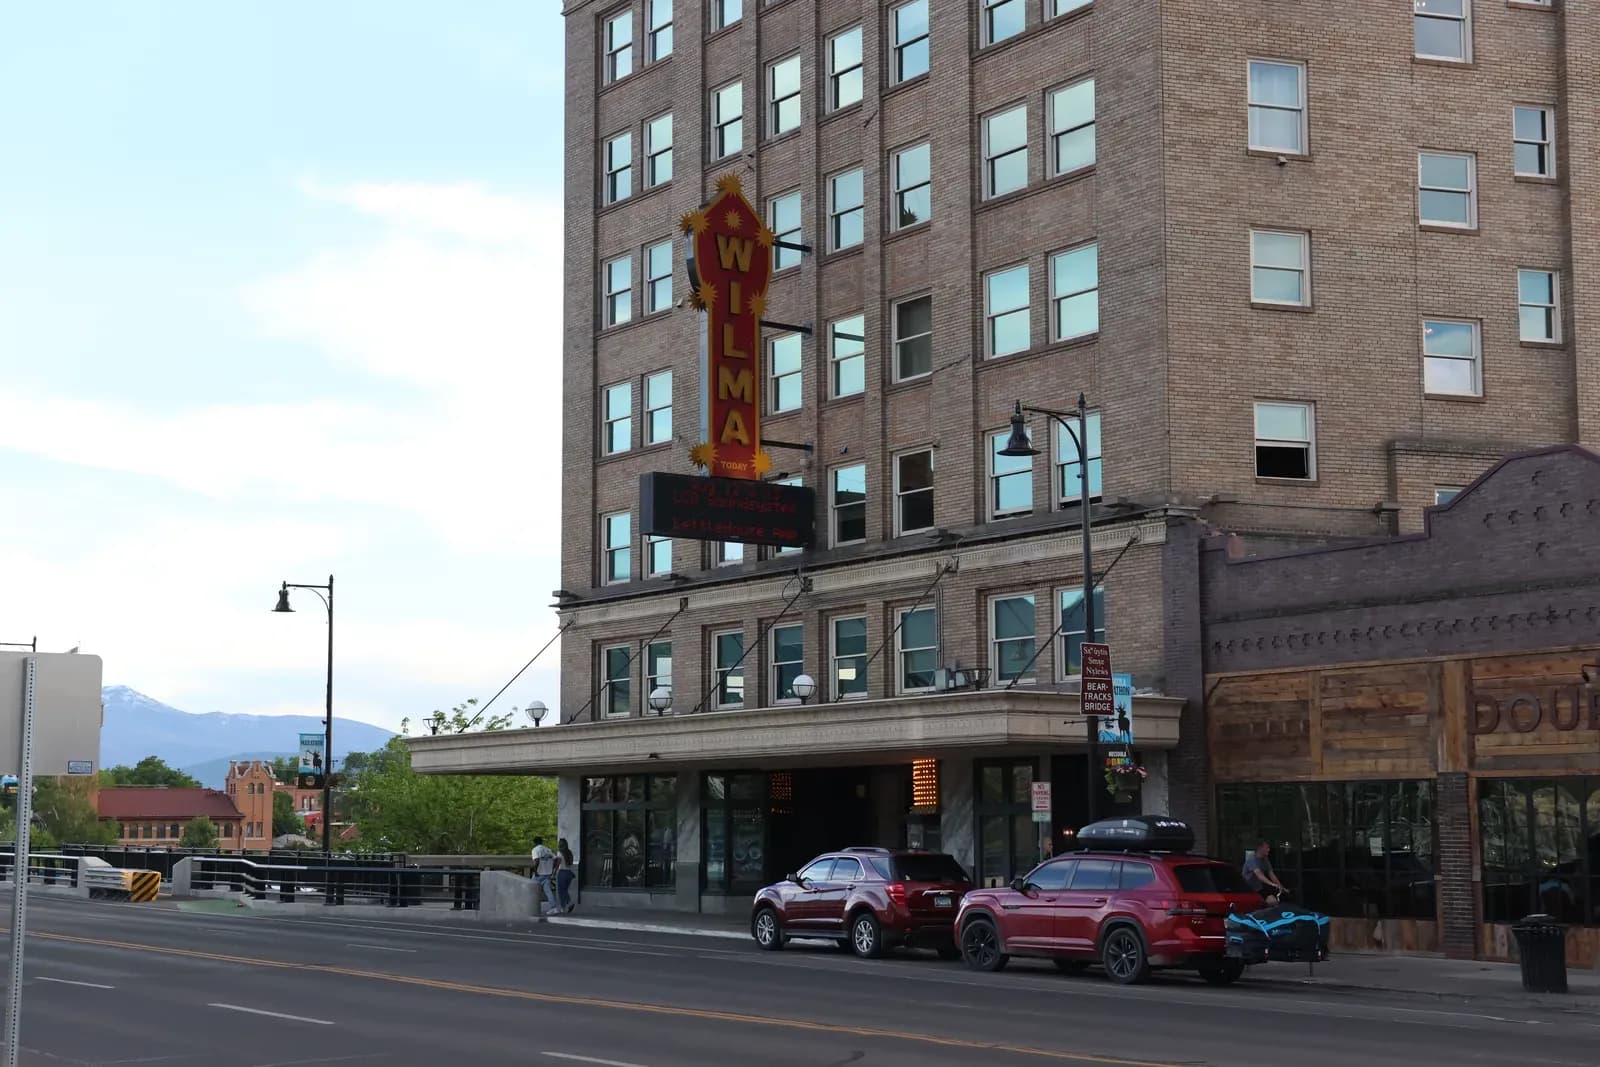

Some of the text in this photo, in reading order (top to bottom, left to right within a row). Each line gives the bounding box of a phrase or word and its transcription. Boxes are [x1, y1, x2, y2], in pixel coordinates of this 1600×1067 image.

[716, 235, 753, 445] WILMA
[720, 460, 748, 471] TODAY
[1087, 682, 1108, 691] BEAR-
[1083, 692, 1112, 702] TRACKS
[1084, 702, 1111, 712] BRIDGE
